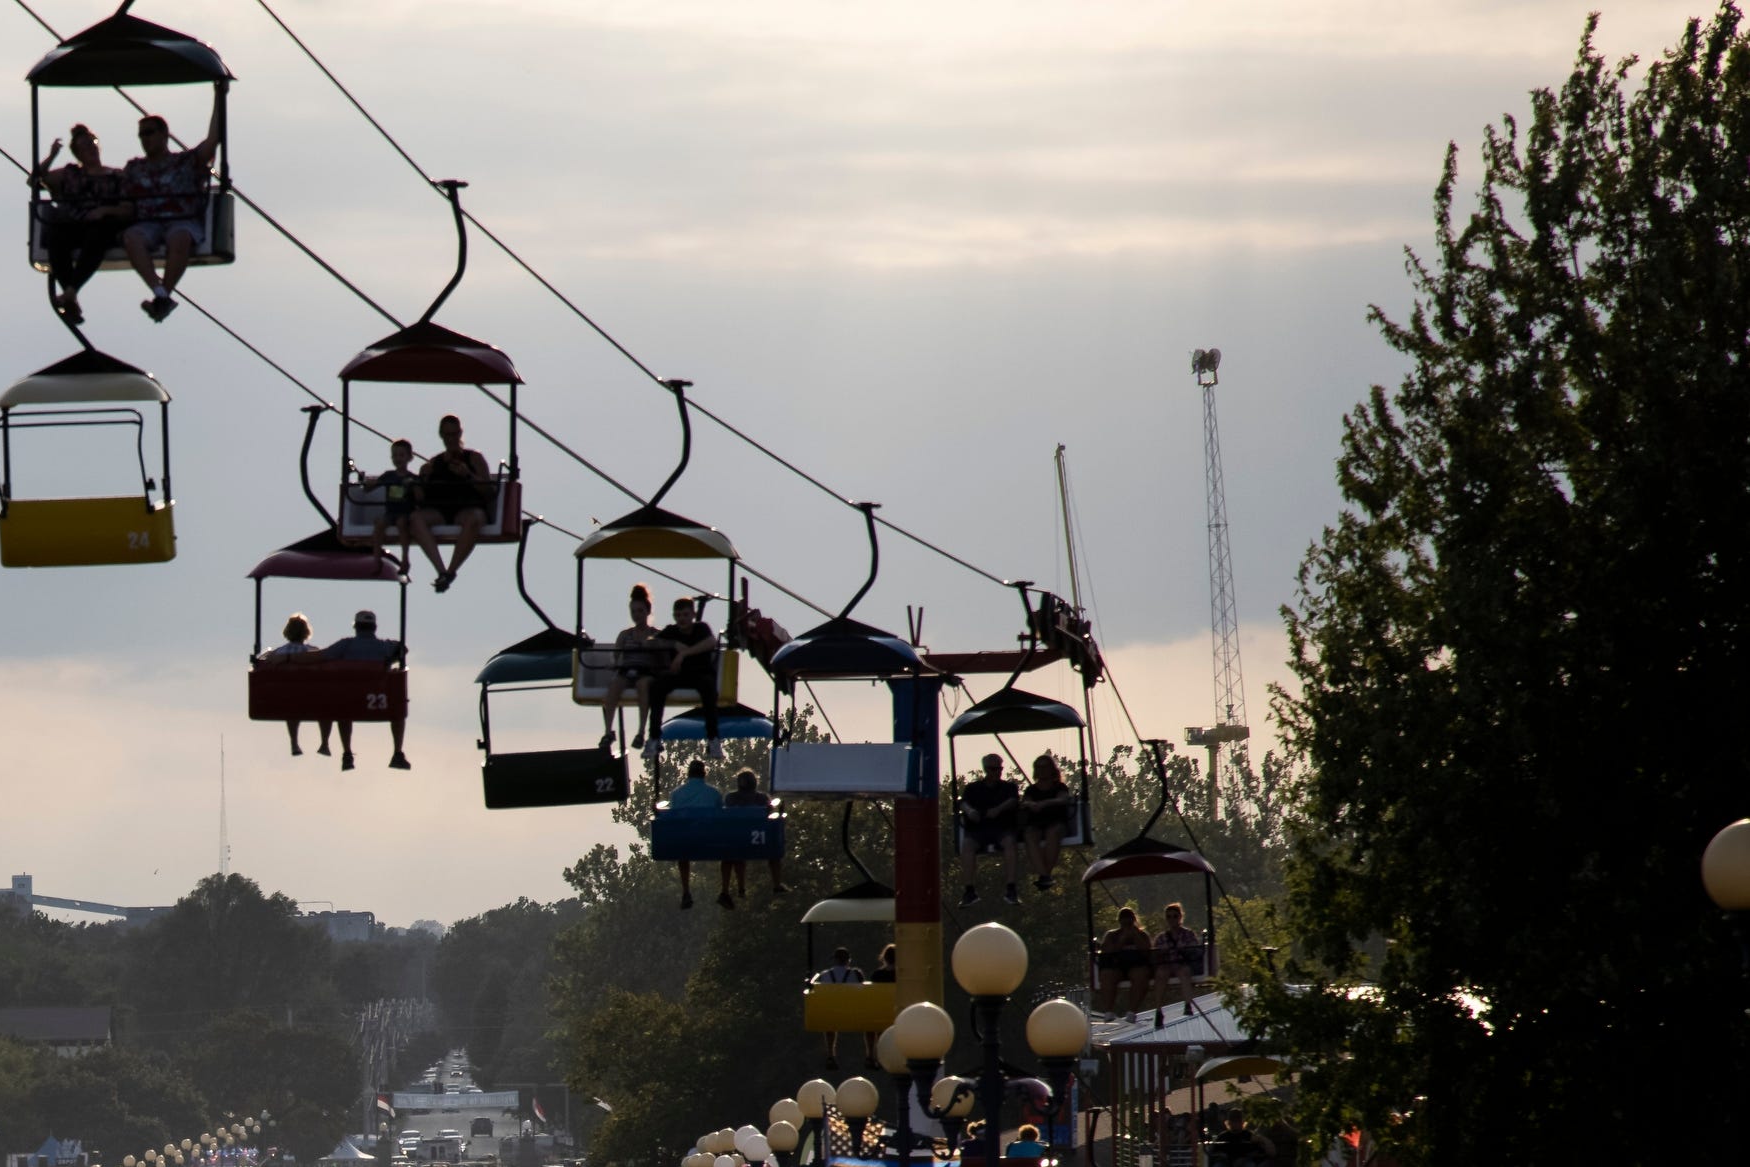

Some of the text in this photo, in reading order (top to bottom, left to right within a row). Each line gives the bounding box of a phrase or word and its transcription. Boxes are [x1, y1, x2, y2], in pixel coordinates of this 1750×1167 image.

[366, 693, 388, 710] 23
[594, 776, 616, 792] 22
[750, 830, 766, 846] 21
